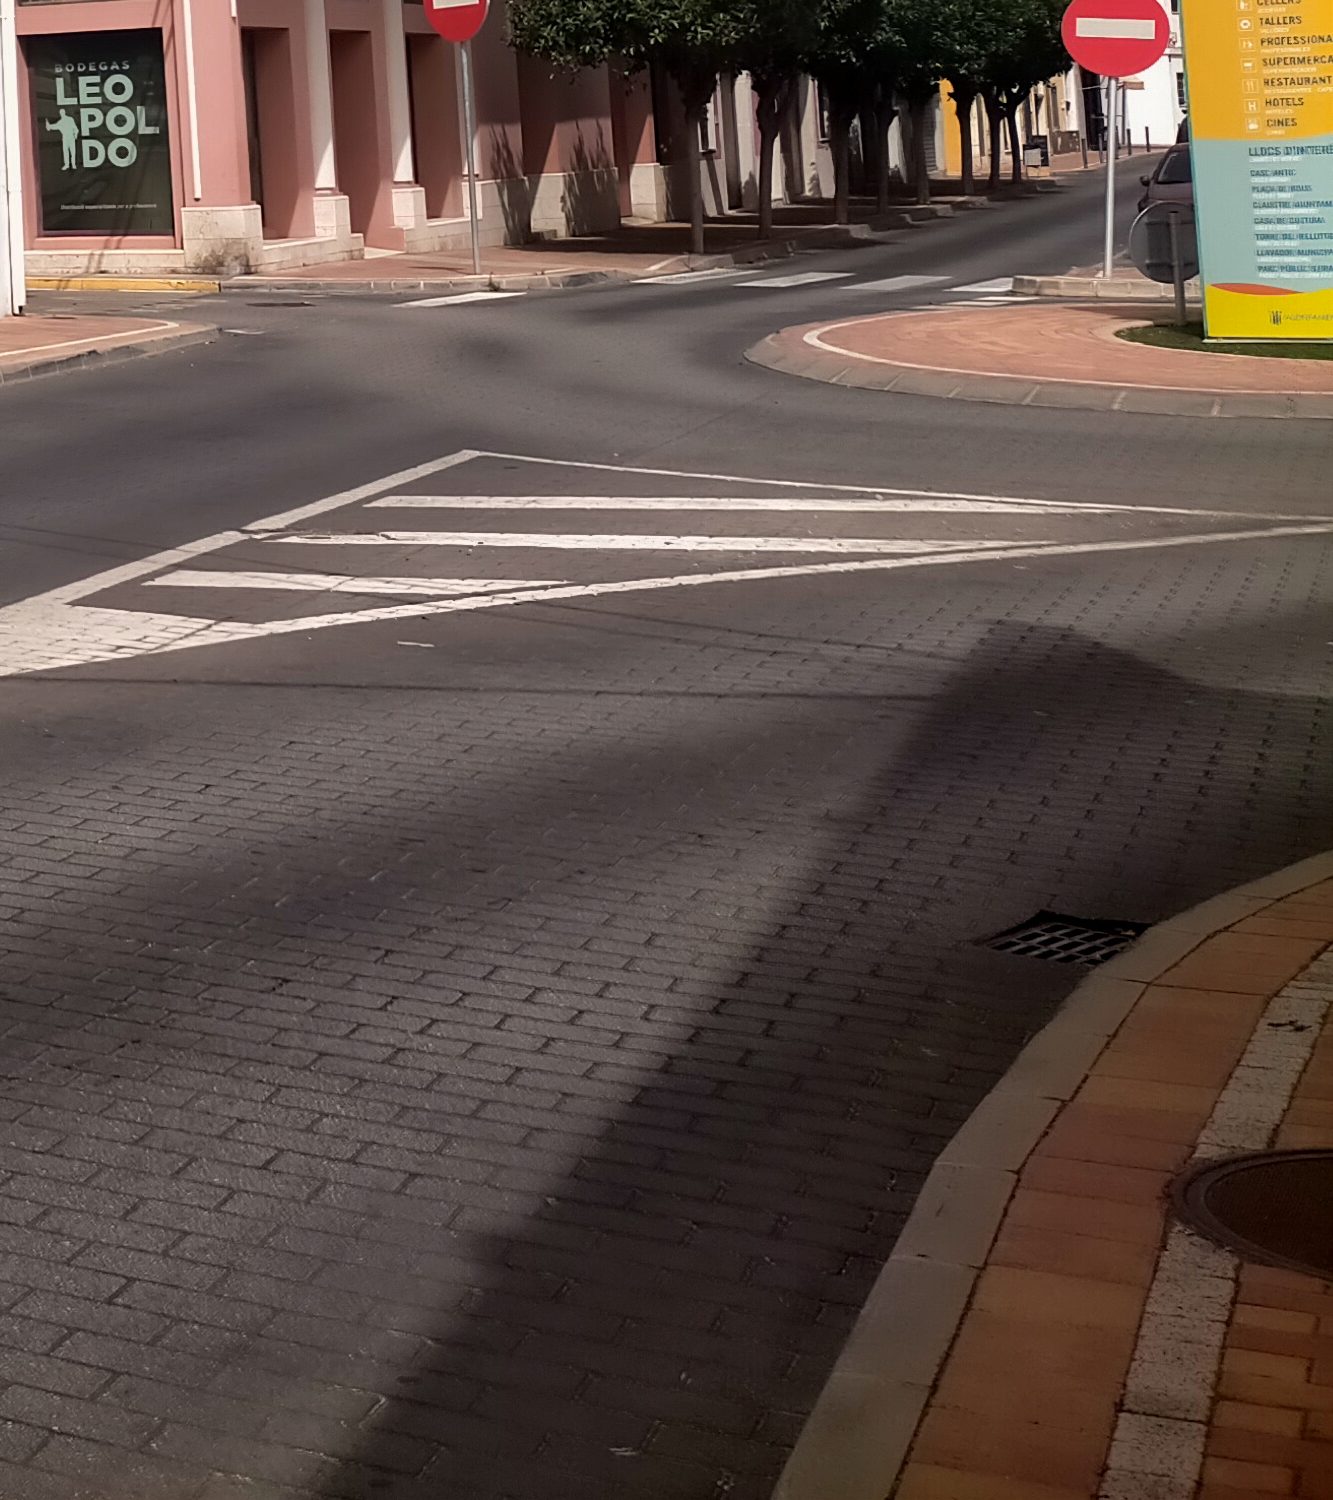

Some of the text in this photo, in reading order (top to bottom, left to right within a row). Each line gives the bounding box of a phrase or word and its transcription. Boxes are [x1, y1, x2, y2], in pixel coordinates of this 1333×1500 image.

[1259, 15, 1302, 26] TALLERS
[54, 60, 130, 73] BODEGAS
[55, 73, 134, 106] LEO
[1265, 97, 1305, 107] HOTELS
[79, 105, 160, 136] POL
[1266, 117, 1298, 128] CINES
[81, 137, 138, 168] DO
